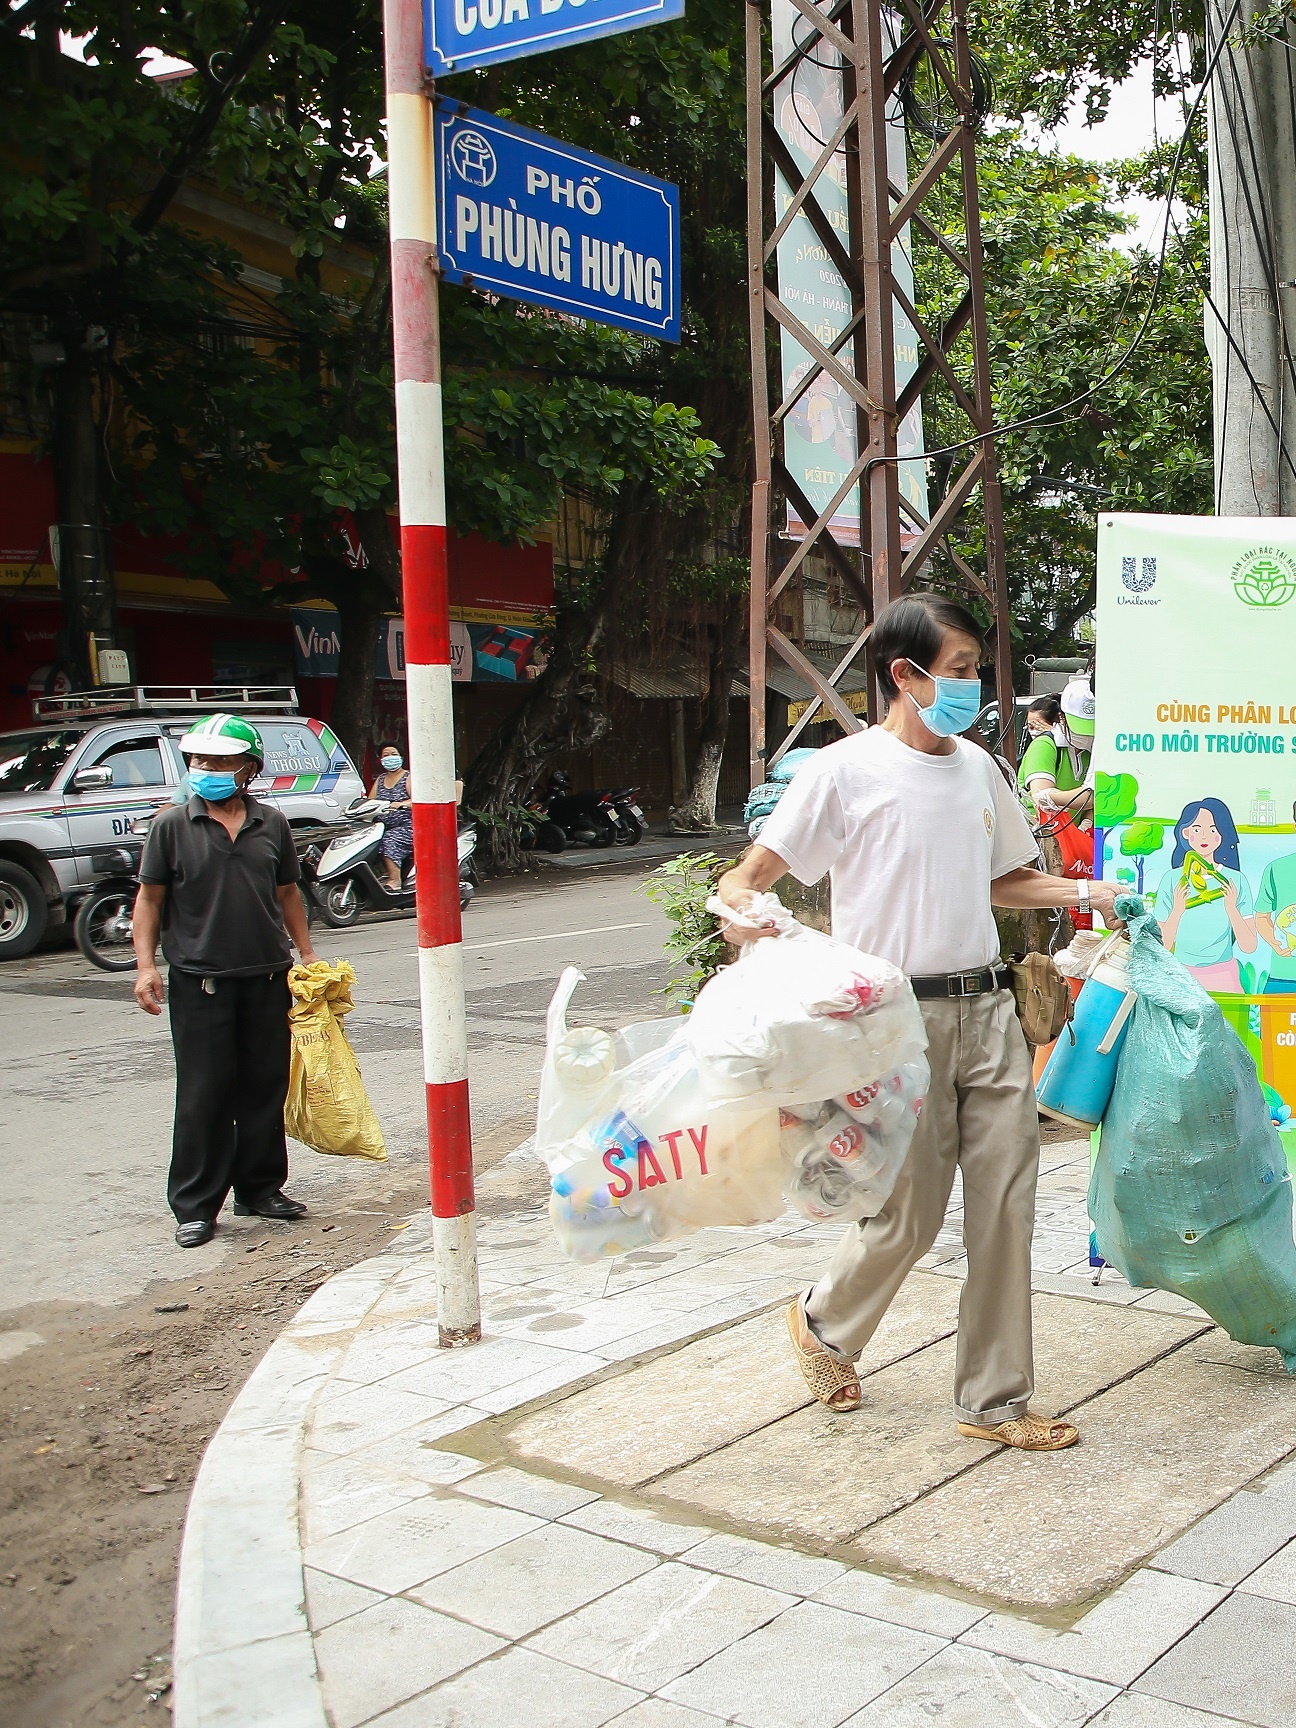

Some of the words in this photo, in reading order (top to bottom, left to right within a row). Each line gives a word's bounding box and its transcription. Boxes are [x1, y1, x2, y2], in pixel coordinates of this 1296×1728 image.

[526, 165, 602, 215] PHỐ
[456, 195, 571, 283] PHÙNG
[581, 234, 663, 311] HƯNG
[1156, 699, 1211, 724] CÙNG
[1217, 701, 1271, 725] PHÂN
[265, 750, 288, 759] NEWS
[1115, 733, 1155, 752] CHO
[1161, 729, 1198, 753] MÔI
[1205, 730, 1285, 754] TRƯỜNG
[270, 755, 303, 772] THỜI
[303, 754, 321, 773] SỰ
[602, 1124, 709, 1198] SATY
